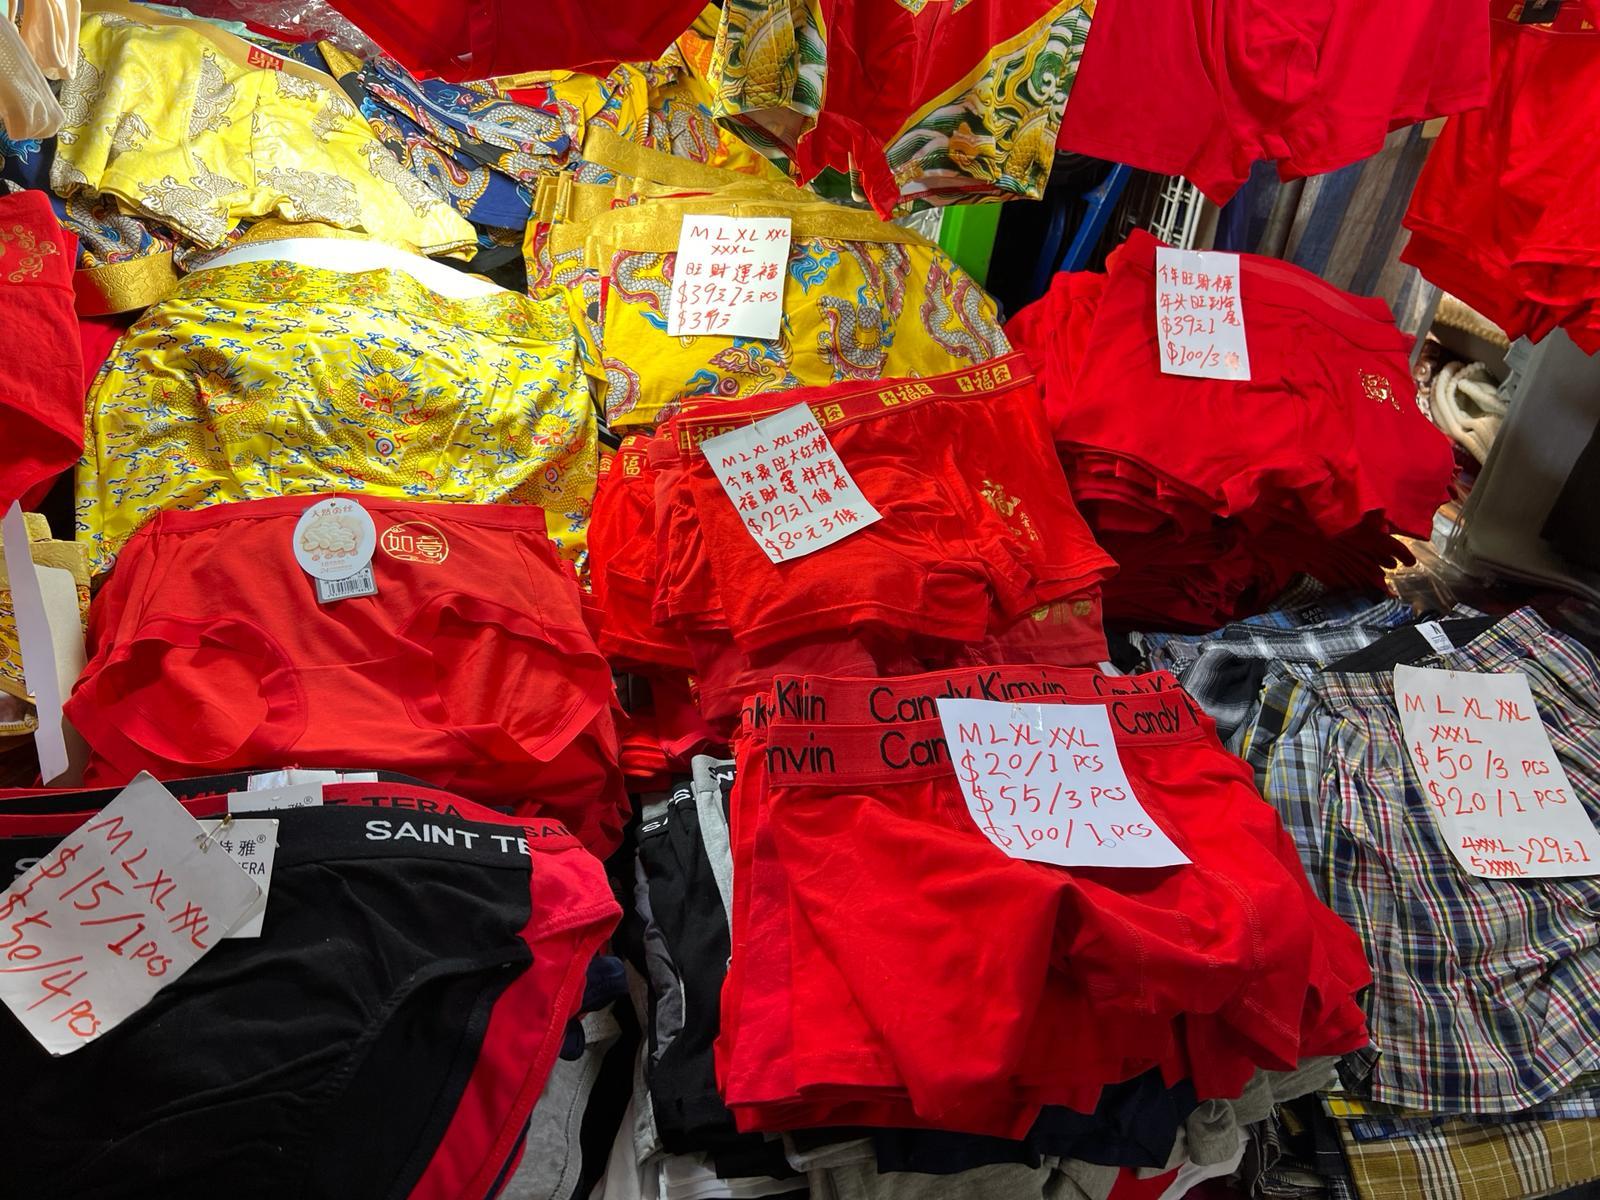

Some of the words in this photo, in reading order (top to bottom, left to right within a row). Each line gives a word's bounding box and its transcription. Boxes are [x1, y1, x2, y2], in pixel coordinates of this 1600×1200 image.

[690, 226, 708, 240] M
[716, 227, 730, 240] L
[735, 228, 758, 242] XL
[765, 228, 789, 241] XXL
[711, 245, 754, 255] XXXL
[722, 456, 737, 468] M
[753, 445, 768, 459] XL
[773, 435, 795, 450] XXL
[1112, 698, 1180, 734] Candy
[1405, 692, 1425, 713] M
[1436, 695, 1455, 714] L
[1462, 697, 1492, 720] XL
[1496, 699, 1531, 723] XXL
[958, 723, 983, 745] M
[989, 724, 1008, 745] L
[1009, 723, 1041, 747] XL
[1048, 726, 1100, 750] XXL
[1429, 725, 1483, 744] XXXL
[88, 816, 133, 855] M
[365, 820, 479, 849] SAINT
[121, 848, 147, 880] L
[132, 869, 176, 911] XL
